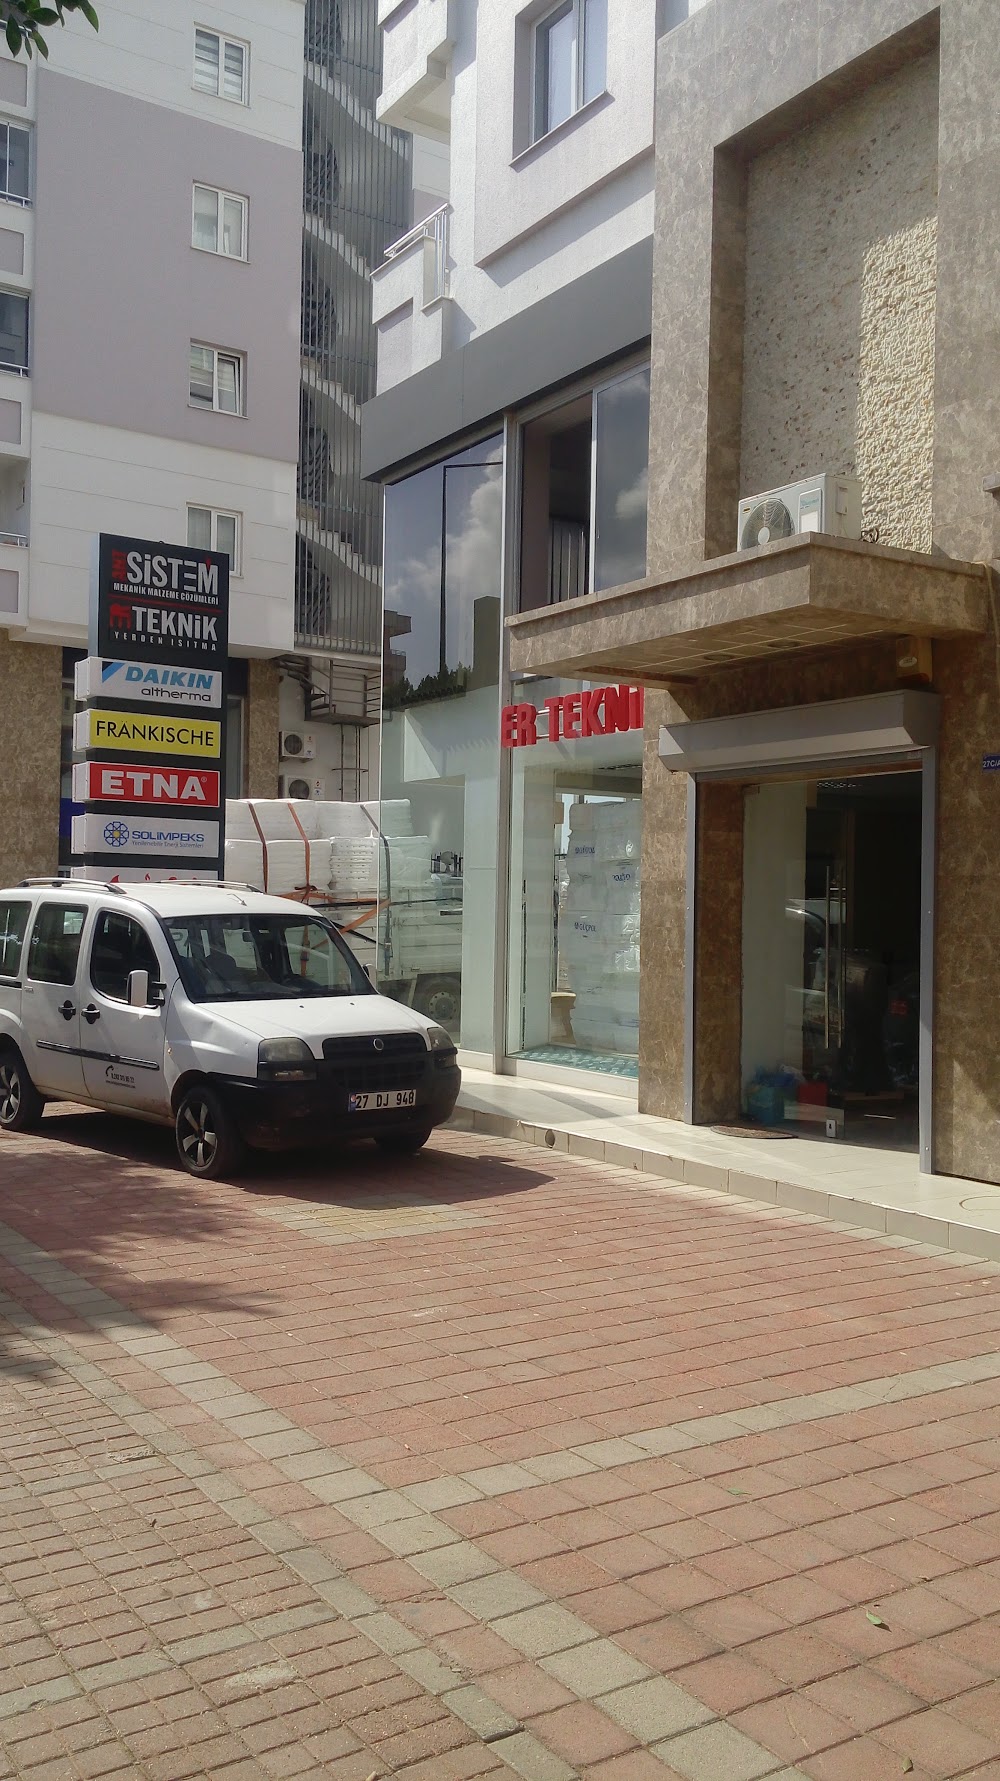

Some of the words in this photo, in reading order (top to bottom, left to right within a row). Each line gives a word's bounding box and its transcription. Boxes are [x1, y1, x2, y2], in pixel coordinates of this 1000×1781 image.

[147, 587, 180, 600] MALZEME
[114, 631, 163, 645] YERDEN
[171, 638, 217, 651] ISITMA
[125, 666, 213, 690] DAIKIN
[141, 687, 212, 702] altherma
[96, 720, 214, 747] FRÄNKISCHE
[501, 702, 537, 748] ER
[356, 1095, 368, 1108] 27
[376, 1093, 389, 1107] DJ
[396, 1091, 414, 1105] 948
